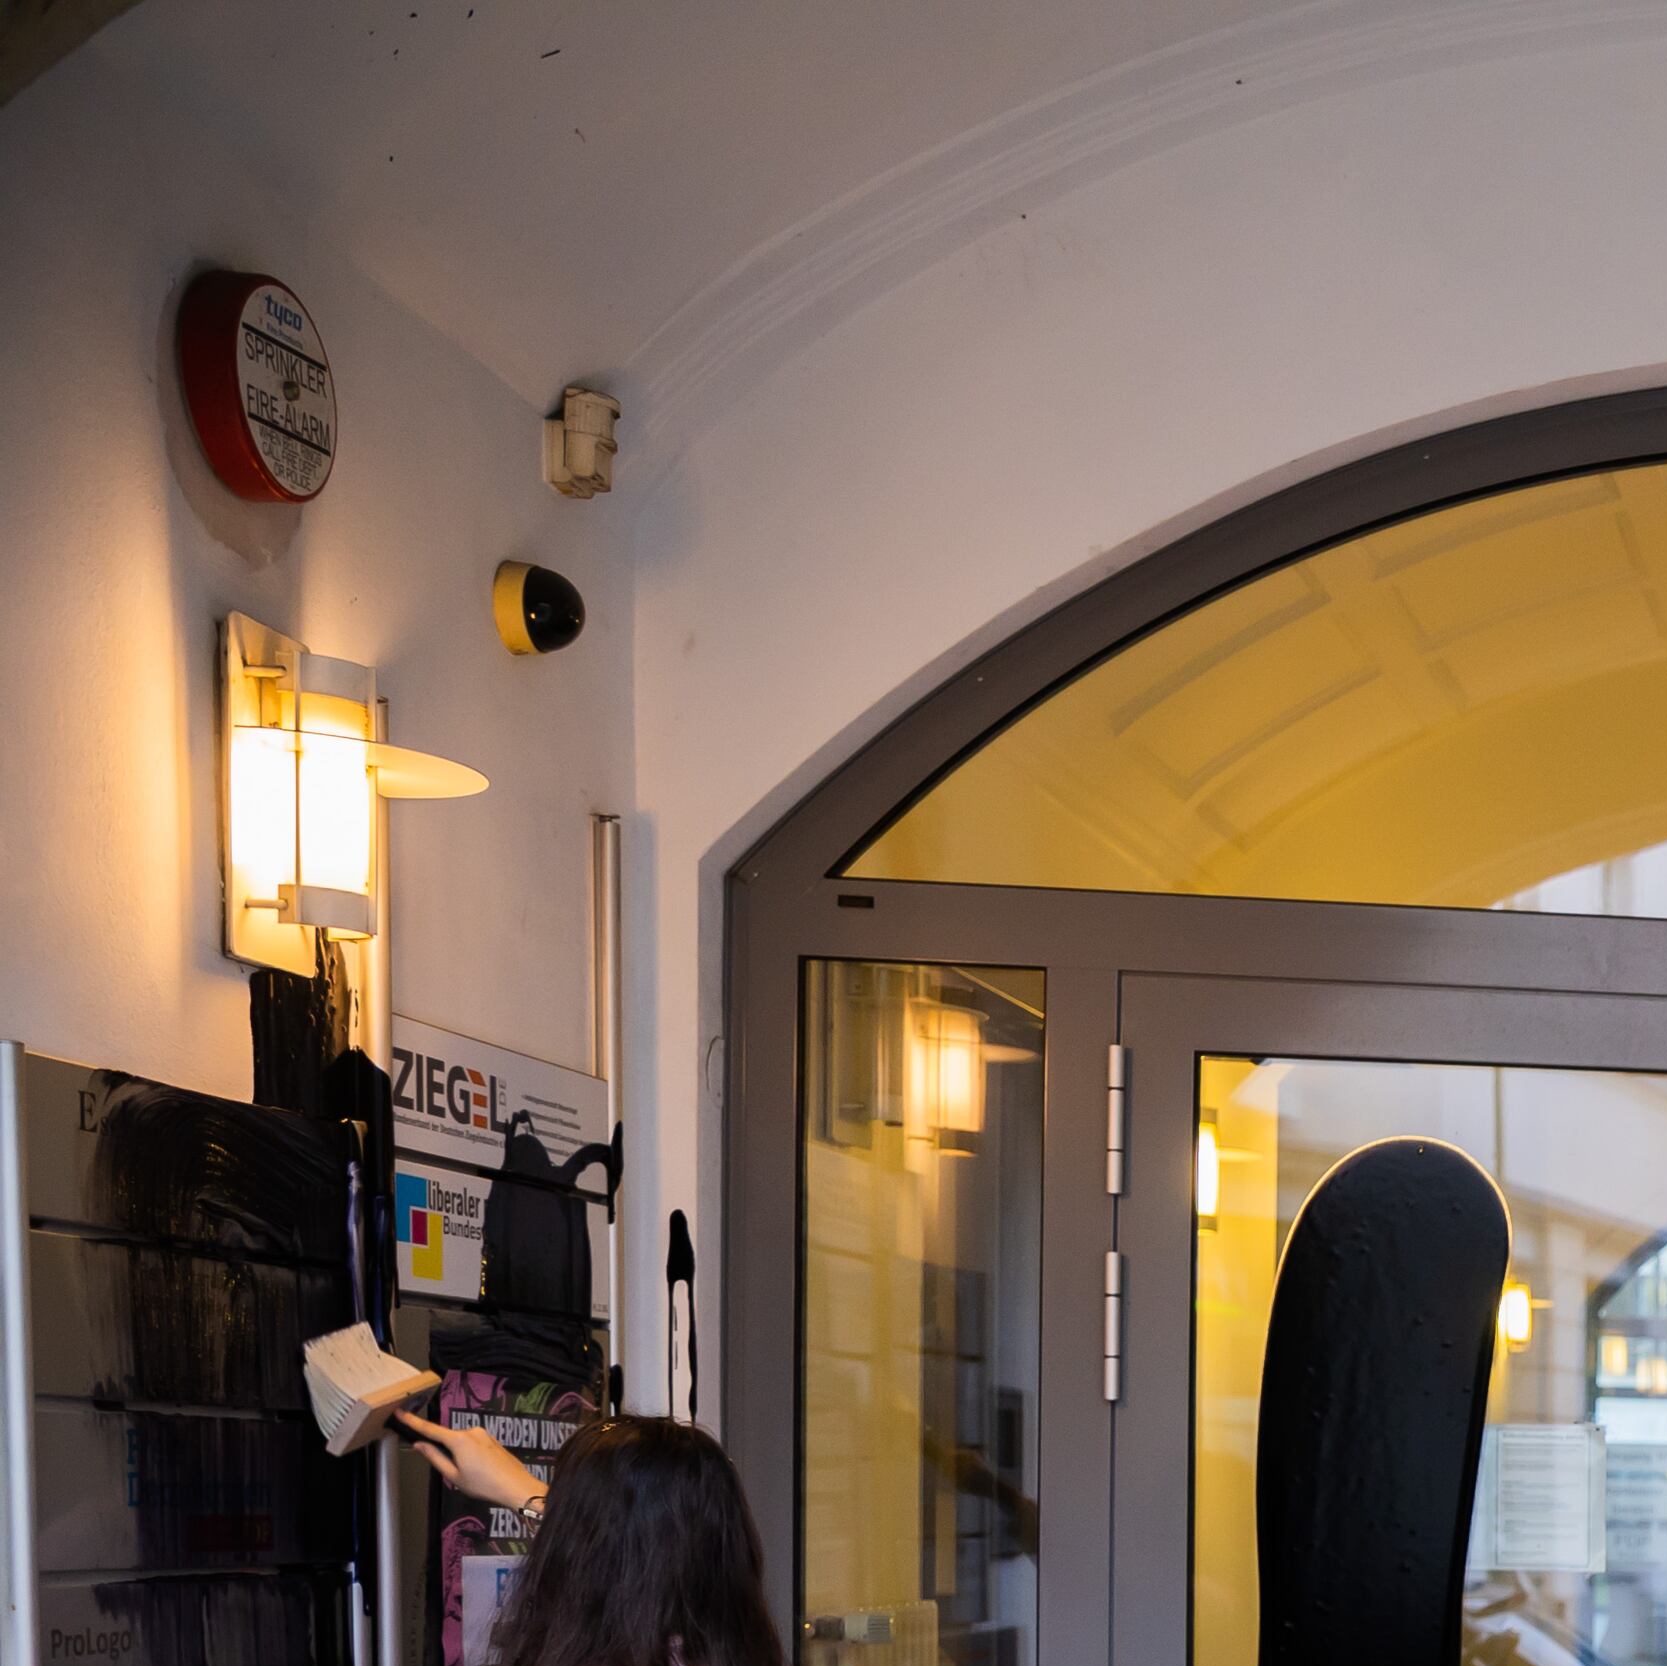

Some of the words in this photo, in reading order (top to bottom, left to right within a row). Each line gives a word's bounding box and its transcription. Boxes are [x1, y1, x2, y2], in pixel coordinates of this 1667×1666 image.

[264, 294, 303, 332] tyco
[244, 331, 328, 399] SPRINKLER
[246, 383, 331, 454] FIRE-ALARM
[393, 1047, 506, 1134] ZIEGEL
[428, 1179, 480, 1219] liberaler
[483, 1415, 538, 1449] WERDEN
[51, 1626, 132, 1662] ProLogo
